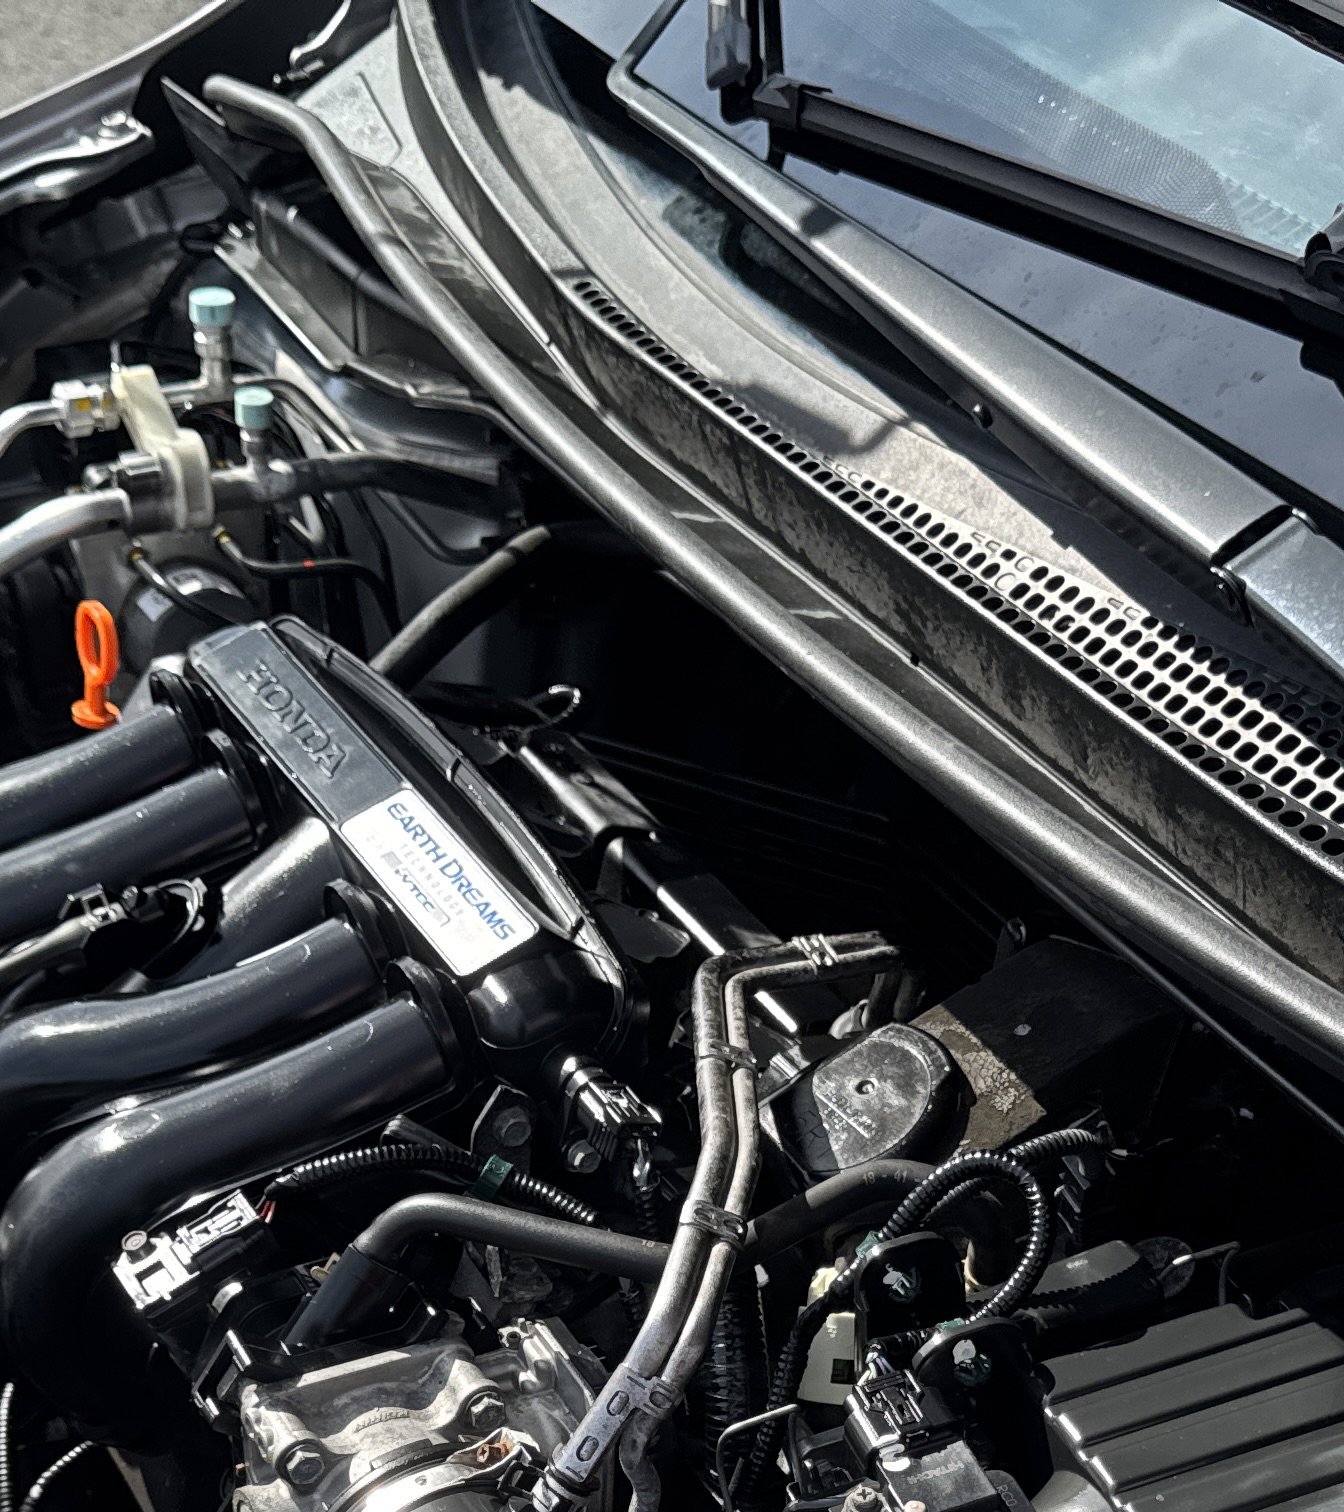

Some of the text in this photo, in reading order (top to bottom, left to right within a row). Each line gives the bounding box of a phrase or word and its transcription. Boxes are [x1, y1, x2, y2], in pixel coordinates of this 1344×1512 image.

[236, 660, 347, 778] HONDA
[387, 802, 516, 940] EARTH DREAMS
